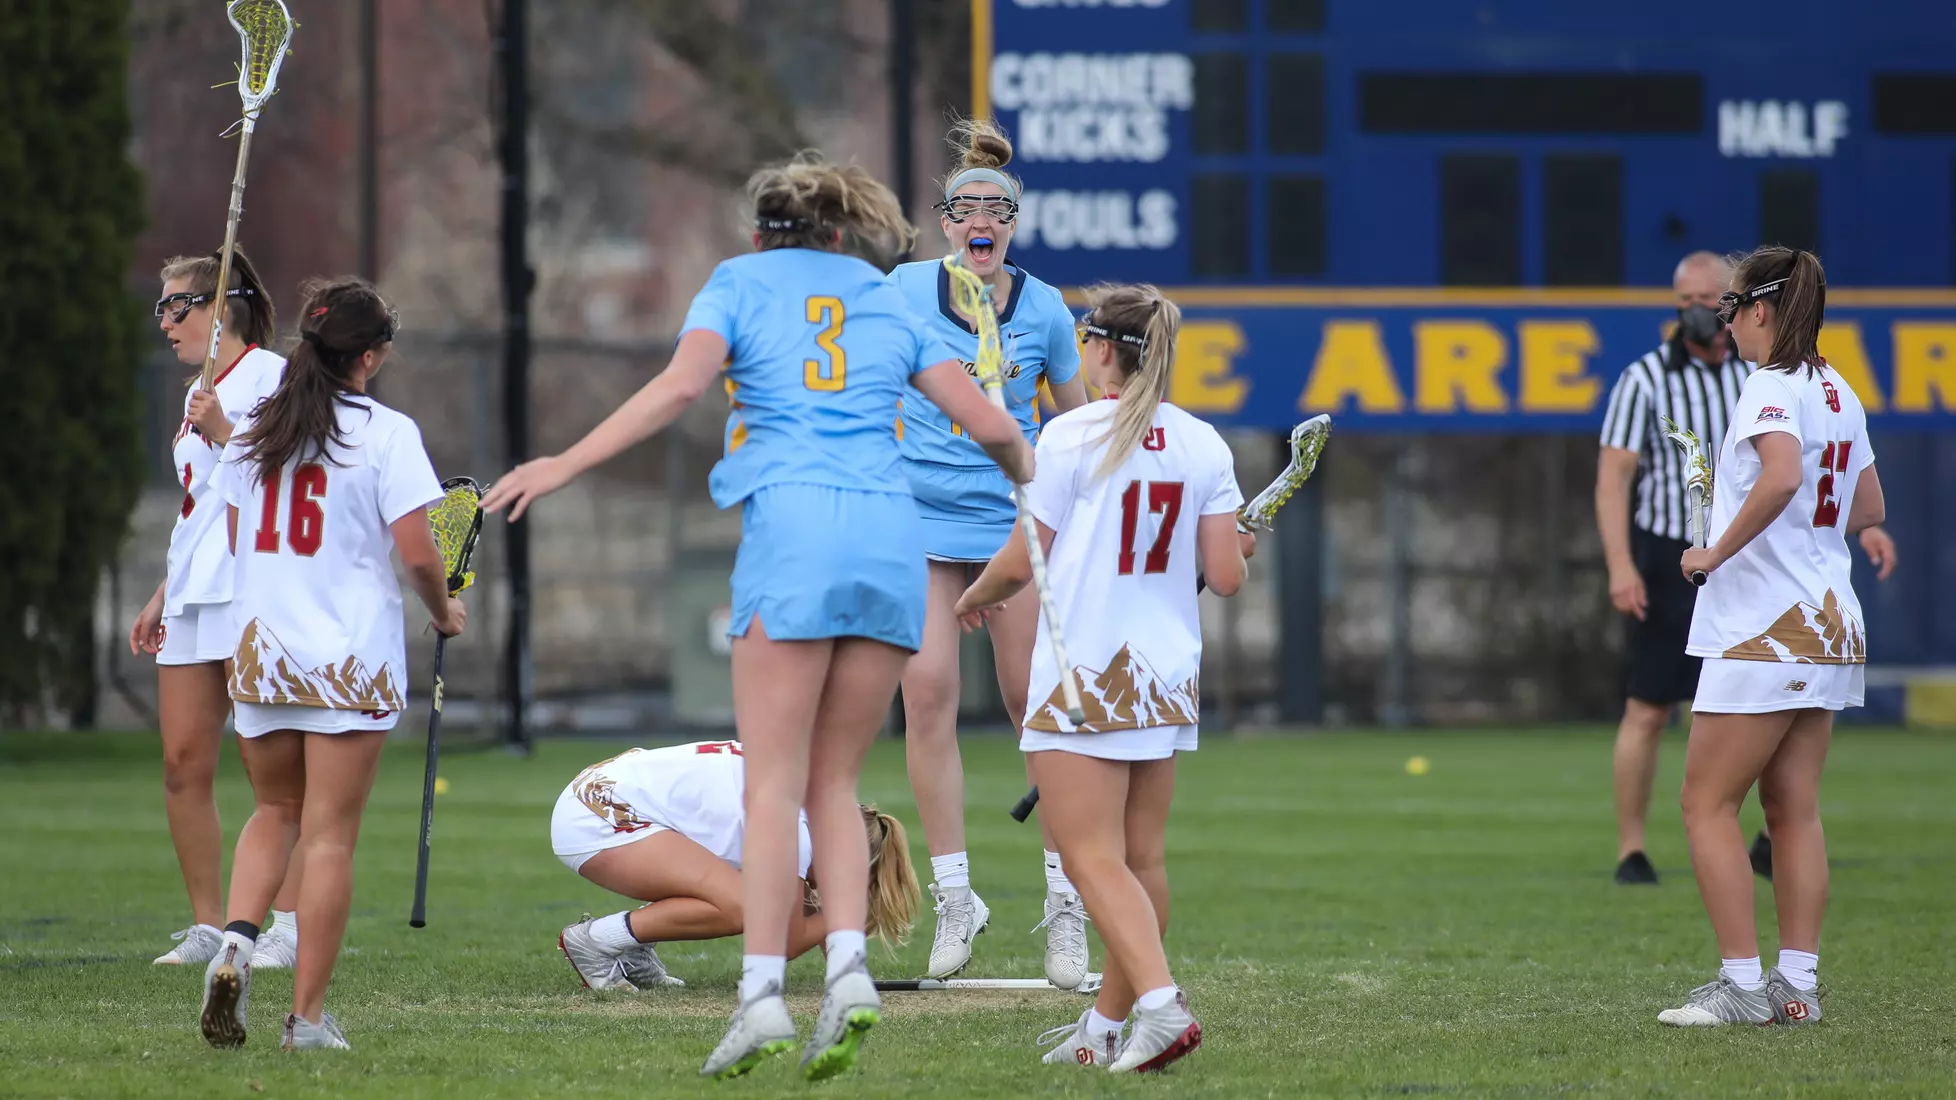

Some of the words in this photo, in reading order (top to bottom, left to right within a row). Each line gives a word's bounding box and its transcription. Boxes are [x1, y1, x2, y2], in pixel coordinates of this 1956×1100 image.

[991, 53, 1195, 110] CORNER
[1018, 108, 1169, 162] KICKS
[1718, 99, 1850, 157] HALF
[1015, 190, 1178, 250] FOULS
[1752, 284, 1780, 298] BRINE
[803, 295, 846, 391] 3
[1301, 319, 1601, 415] ARE
[1761, 406, 1785, 414] BIG
[254, 463, 327, 558] 16
[1118, 479, 1185, 576] 17
[1783, 1000, 1810, 1021] DU
